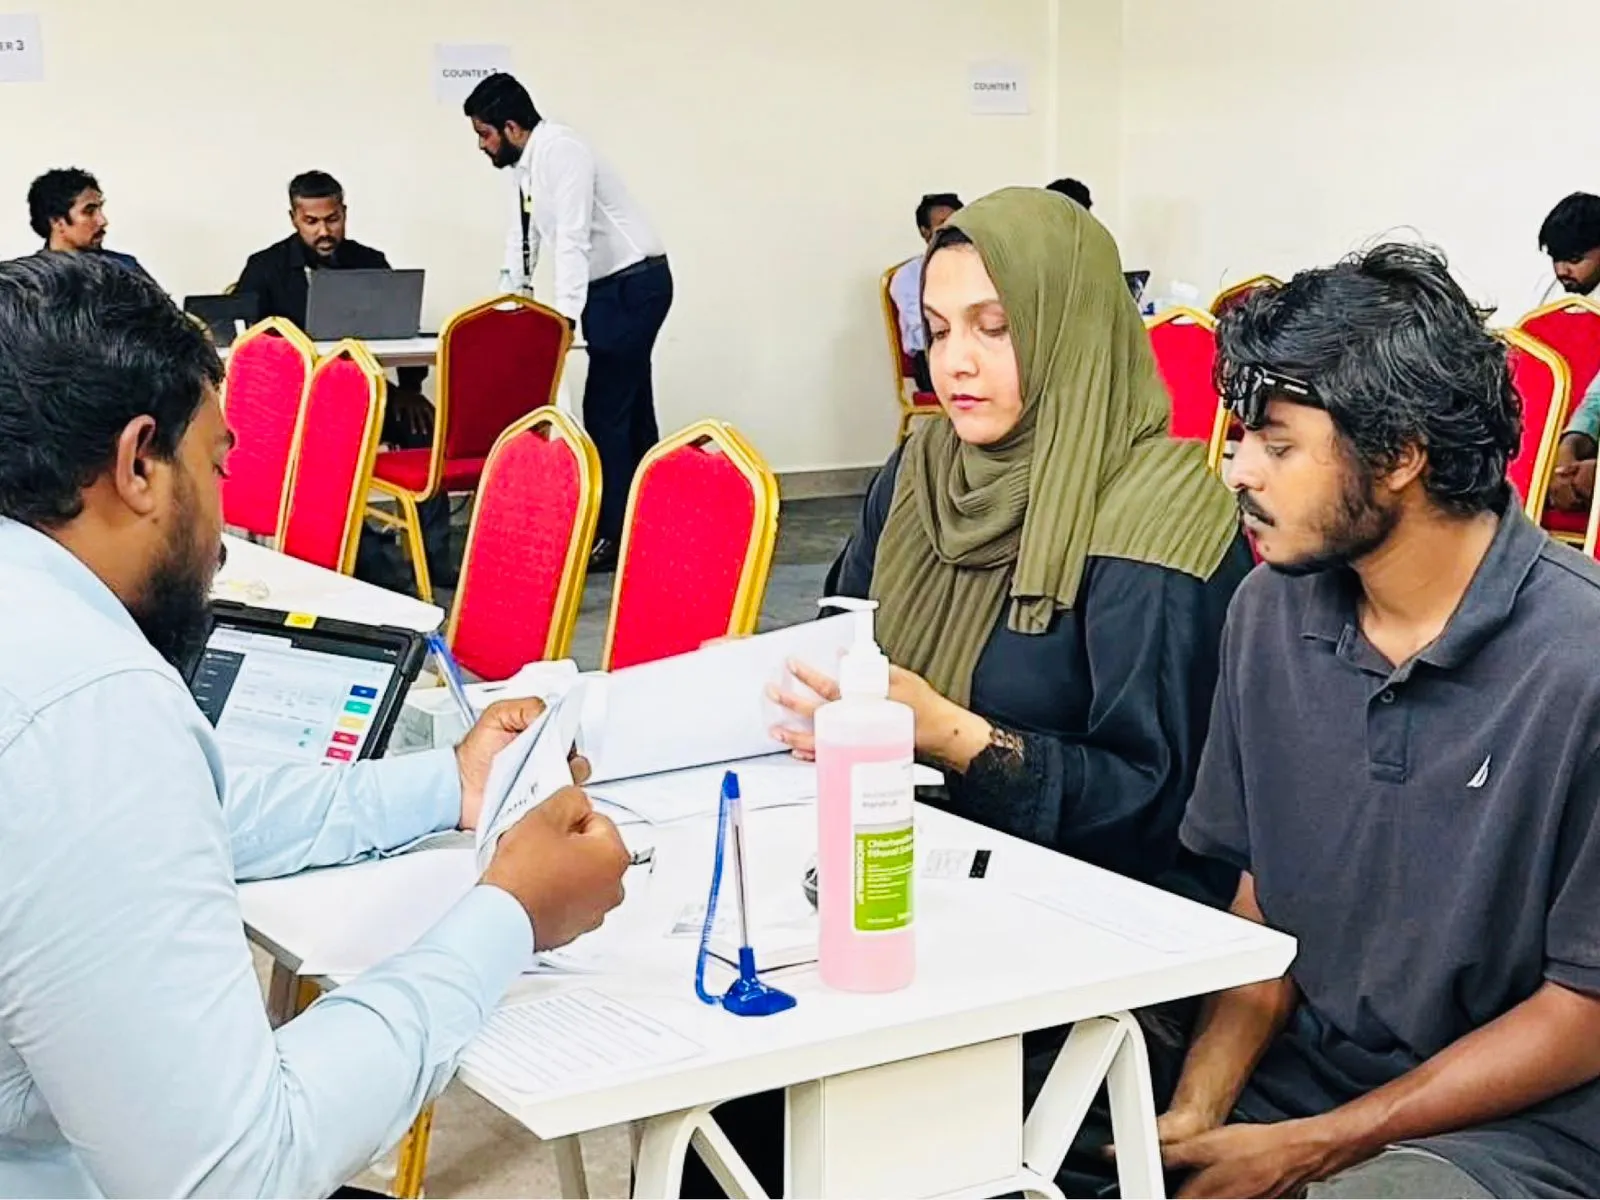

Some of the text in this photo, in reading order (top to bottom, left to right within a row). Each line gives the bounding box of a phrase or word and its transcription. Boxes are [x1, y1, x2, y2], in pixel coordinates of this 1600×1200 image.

[16, 39, 25, 51] 3
[442, 69, 489, 78] COUNTER
[973, 81, 1017, 91] COUNTER 1
